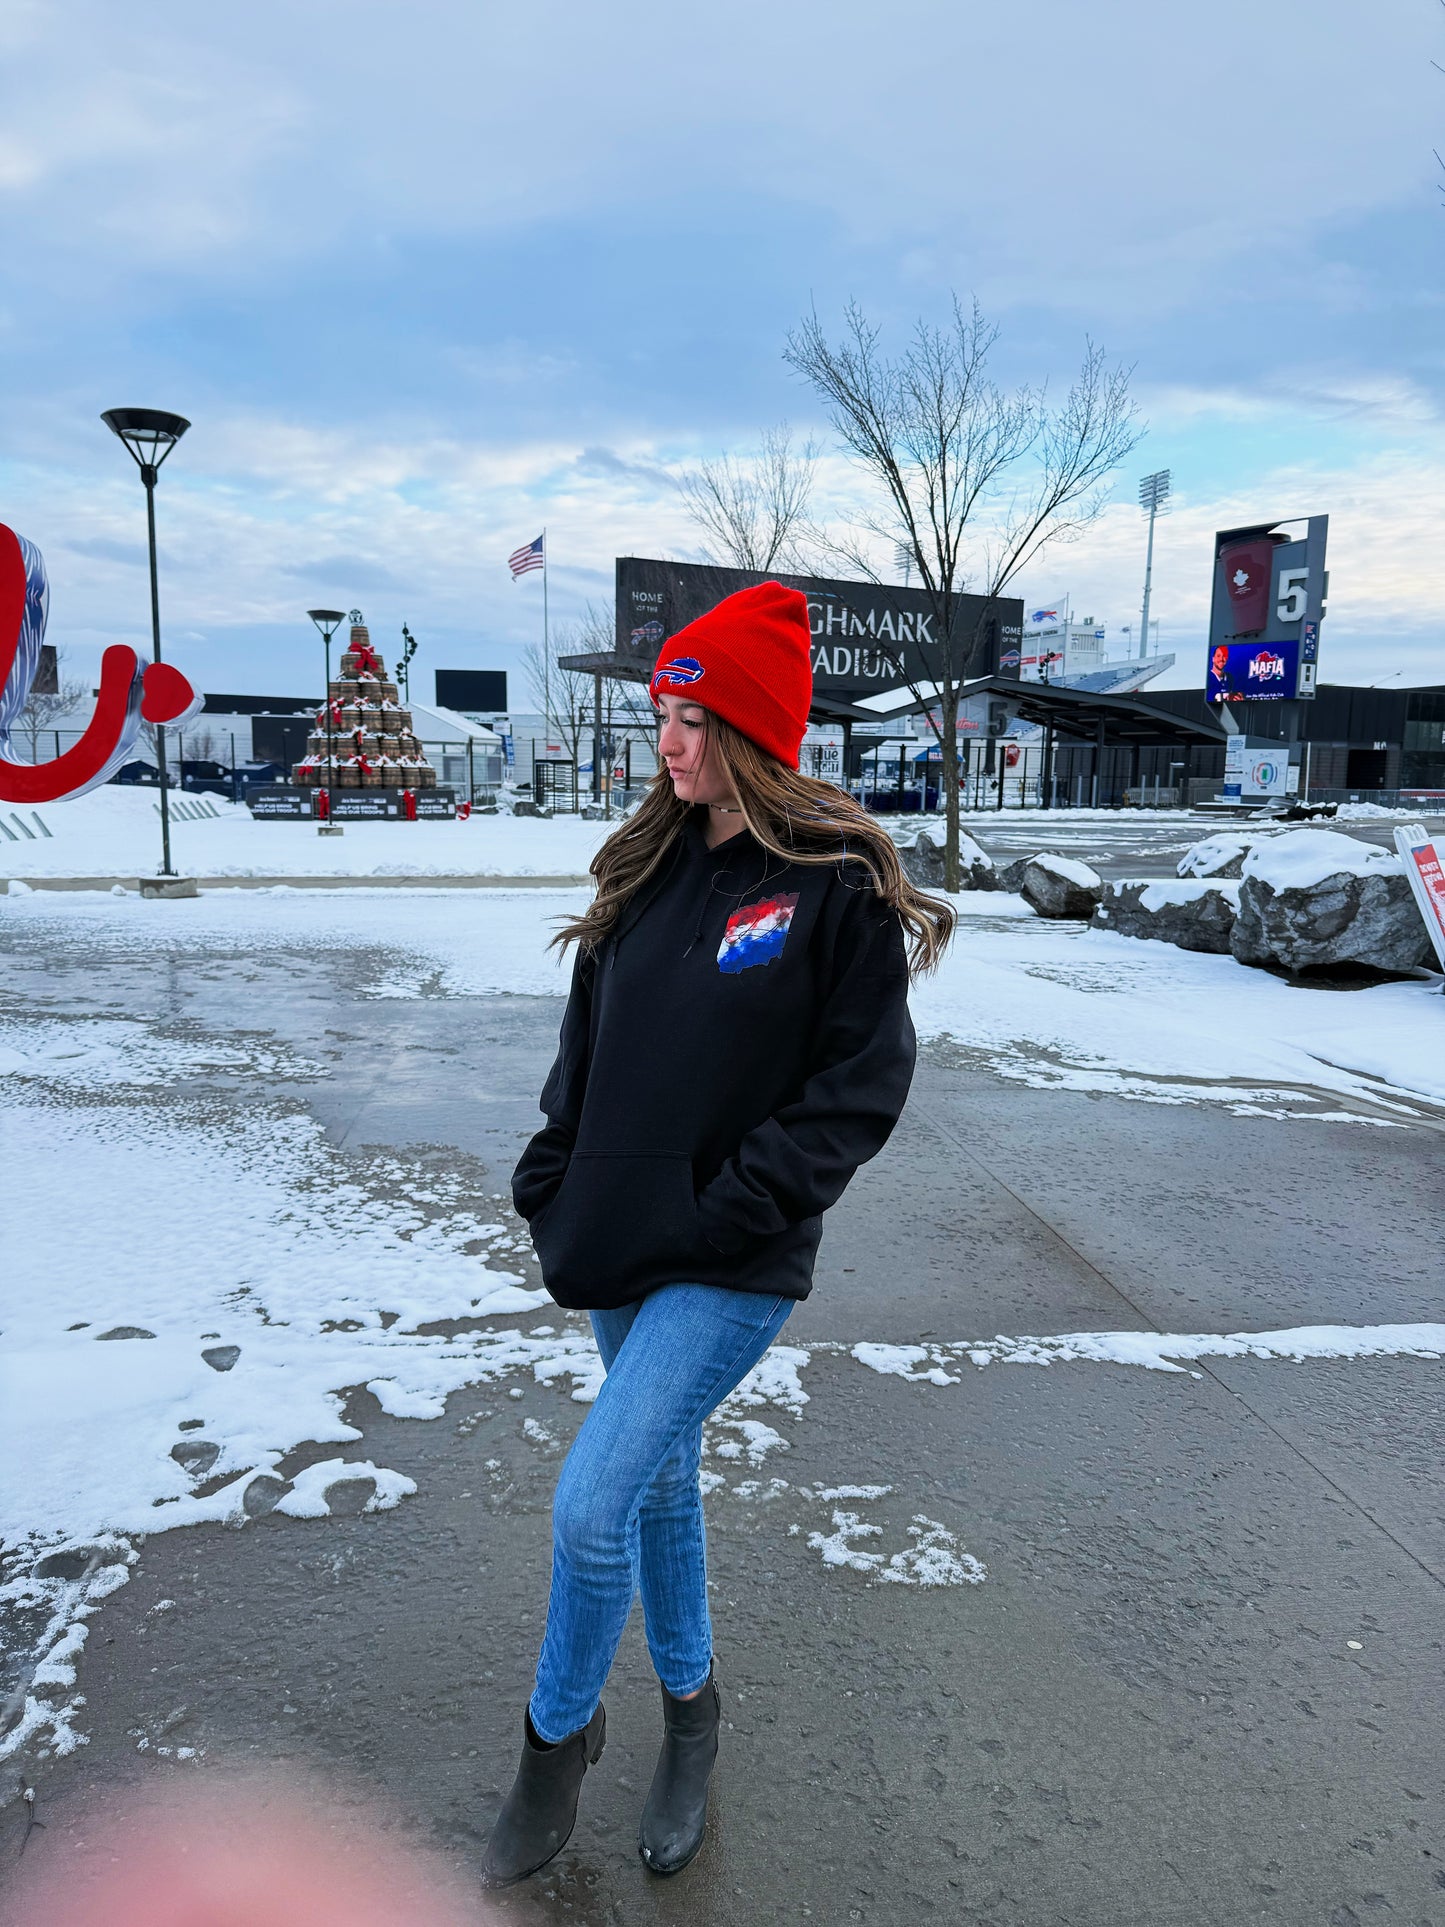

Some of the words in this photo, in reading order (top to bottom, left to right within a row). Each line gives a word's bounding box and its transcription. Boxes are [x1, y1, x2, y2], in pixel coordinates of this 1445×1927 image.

[632, 591, 663, 604] HOME
[1277, 567, 1310, 622] 5
[807, 603, 934, 644] GHMARK
[811, 645, 906, 679] ADIUM
[1249, 659, 1285, 679] MAFIA
[989, 702, 1008, 737] 5
